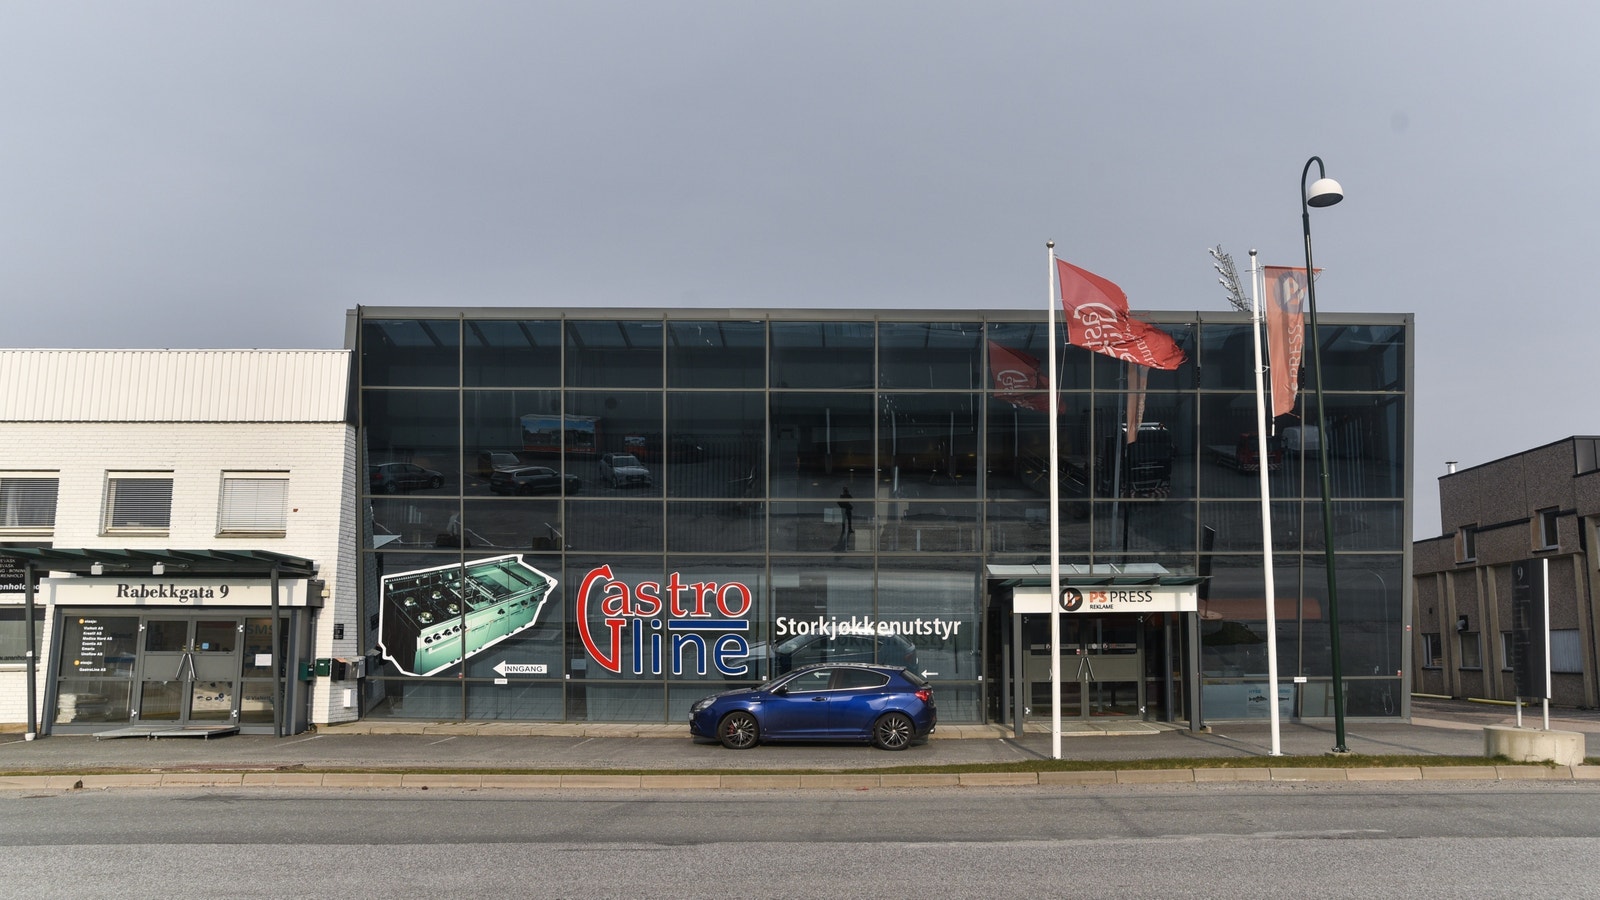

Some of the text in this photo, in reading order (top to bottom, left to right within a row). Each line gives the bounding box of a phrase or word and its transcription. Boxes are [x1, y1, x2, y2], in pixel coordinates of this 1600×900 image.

[116, 584, 230, 603] Rabekkgata 9
[1089, 590, 1153, 602] PS PRESS
[776, 616, 962, 640] Storkjøkkenutstyr
